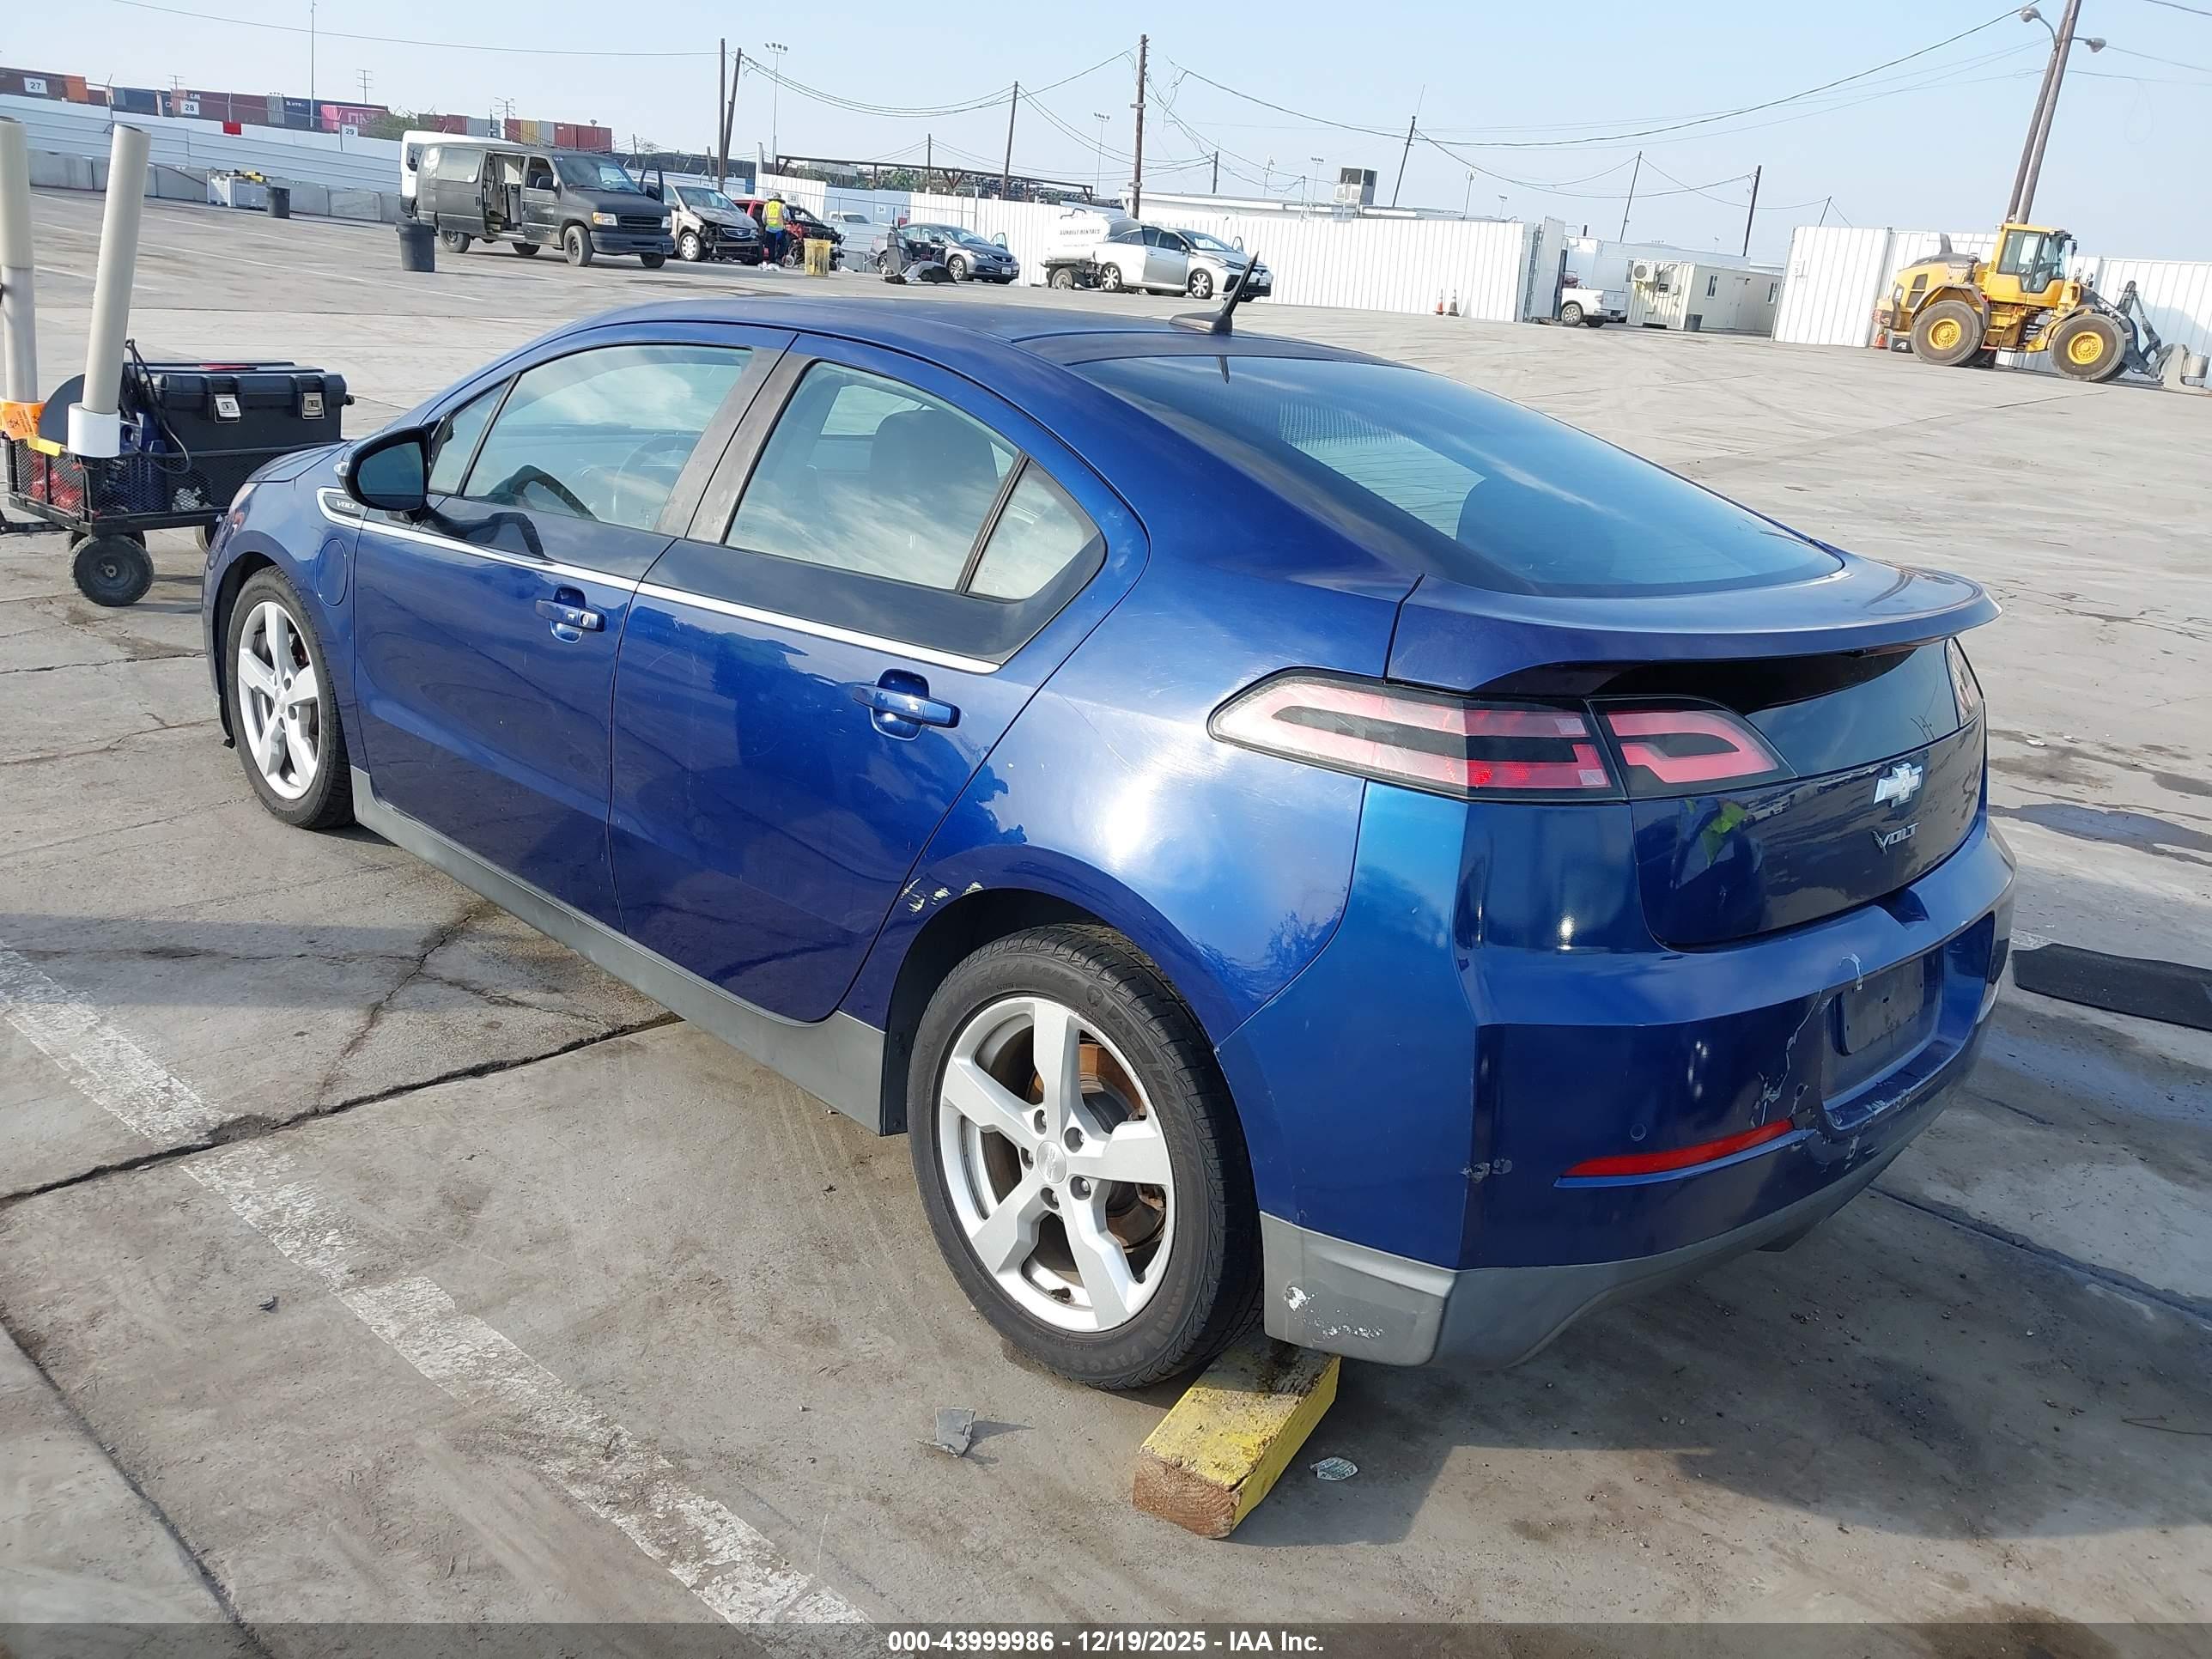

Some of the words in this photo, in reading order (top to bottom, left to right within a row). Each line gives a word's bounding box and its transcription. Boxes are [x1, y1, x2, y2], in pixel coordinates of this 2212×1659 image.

[29, 82, 41, 90] 27
[185, 103, 195, 112] 28
[336, 499, 356, 509] VOLT
[1871, 822, 1920, 856] VOLT
